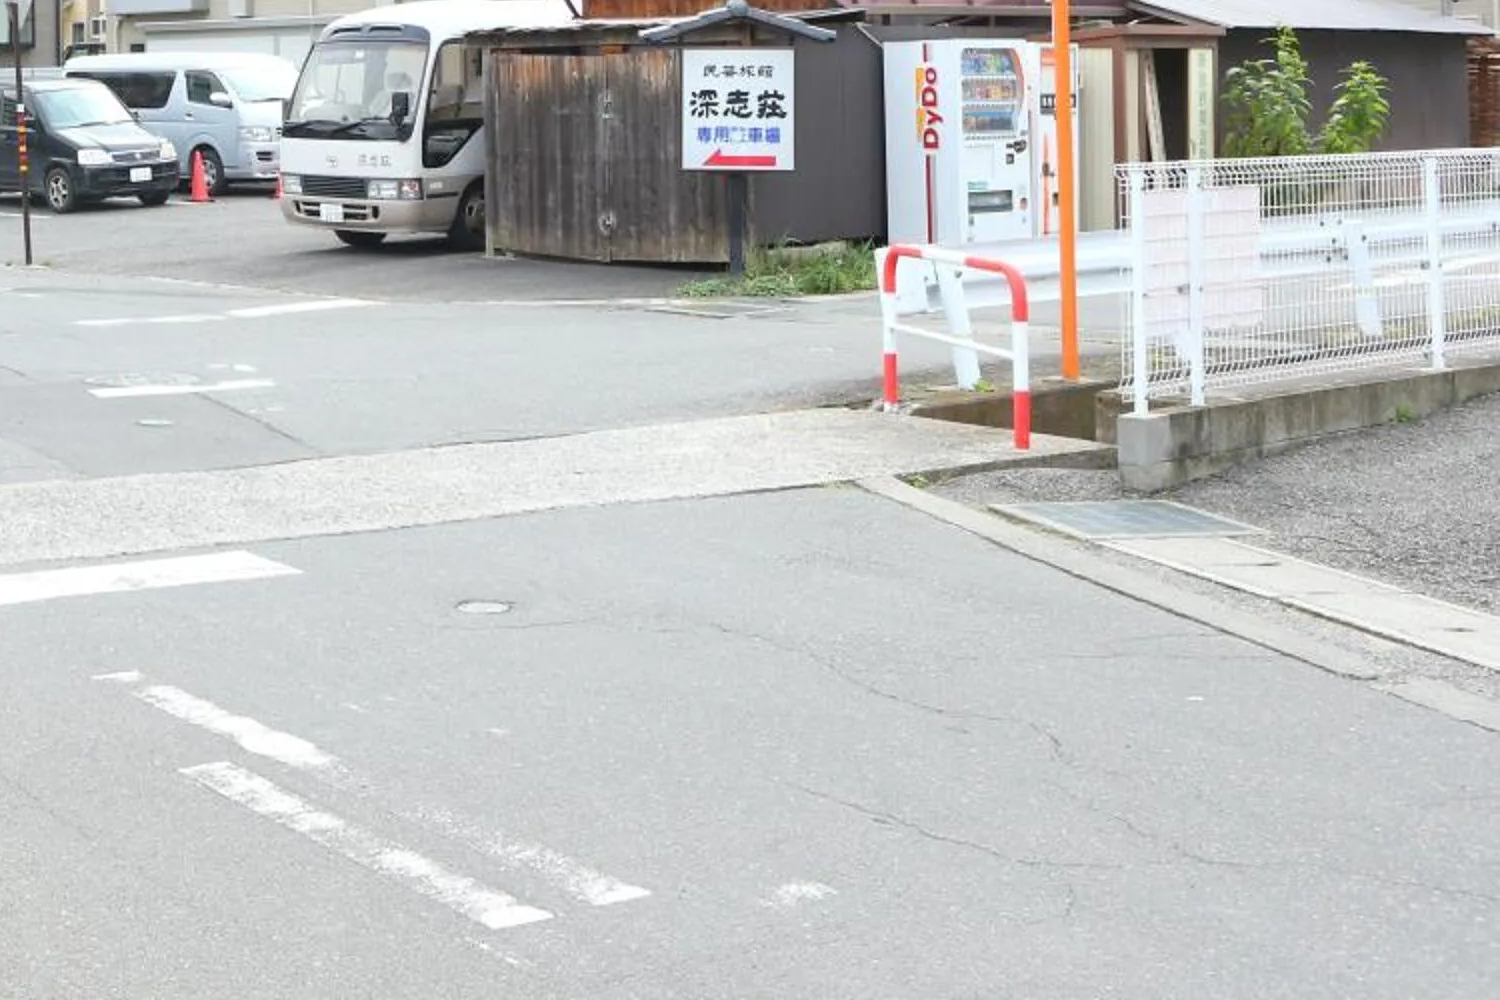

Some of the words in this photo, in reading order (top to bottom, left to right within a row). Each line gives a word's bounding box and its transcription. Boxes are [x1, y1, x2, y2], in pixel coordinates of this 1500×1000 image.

[689, 89, 788, 119] 深志荘
[922, 67, 943, 149] DyDo
